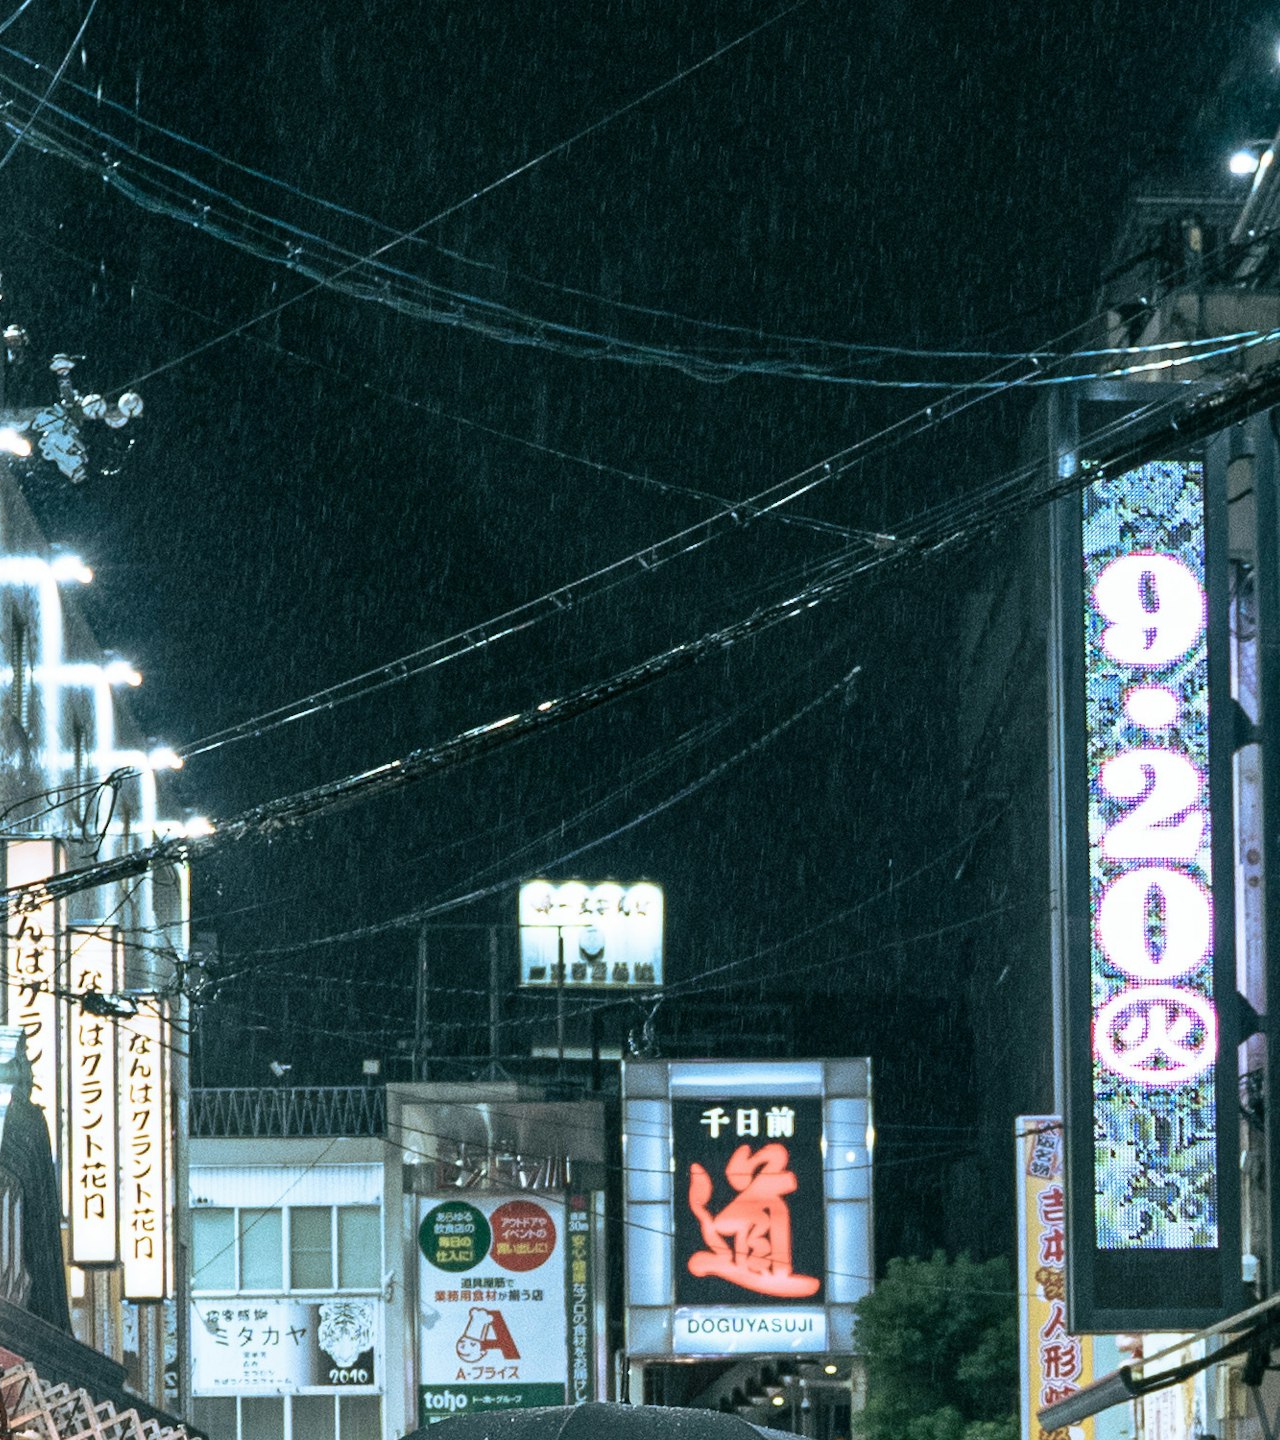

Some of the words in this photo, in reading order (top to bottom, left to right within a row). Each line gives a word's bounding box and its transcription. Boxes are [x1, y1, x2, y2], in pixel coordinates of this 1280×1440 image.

[700, 1106, 795, 1139] 千日前
[215, 1325, 308, 1348] ミタカヤ
[687, 1318, 814, 1334] DOGUYASUJI
[328, 1368, 369, 1384] 2010
[423, 1389, 468, 1412] toho
